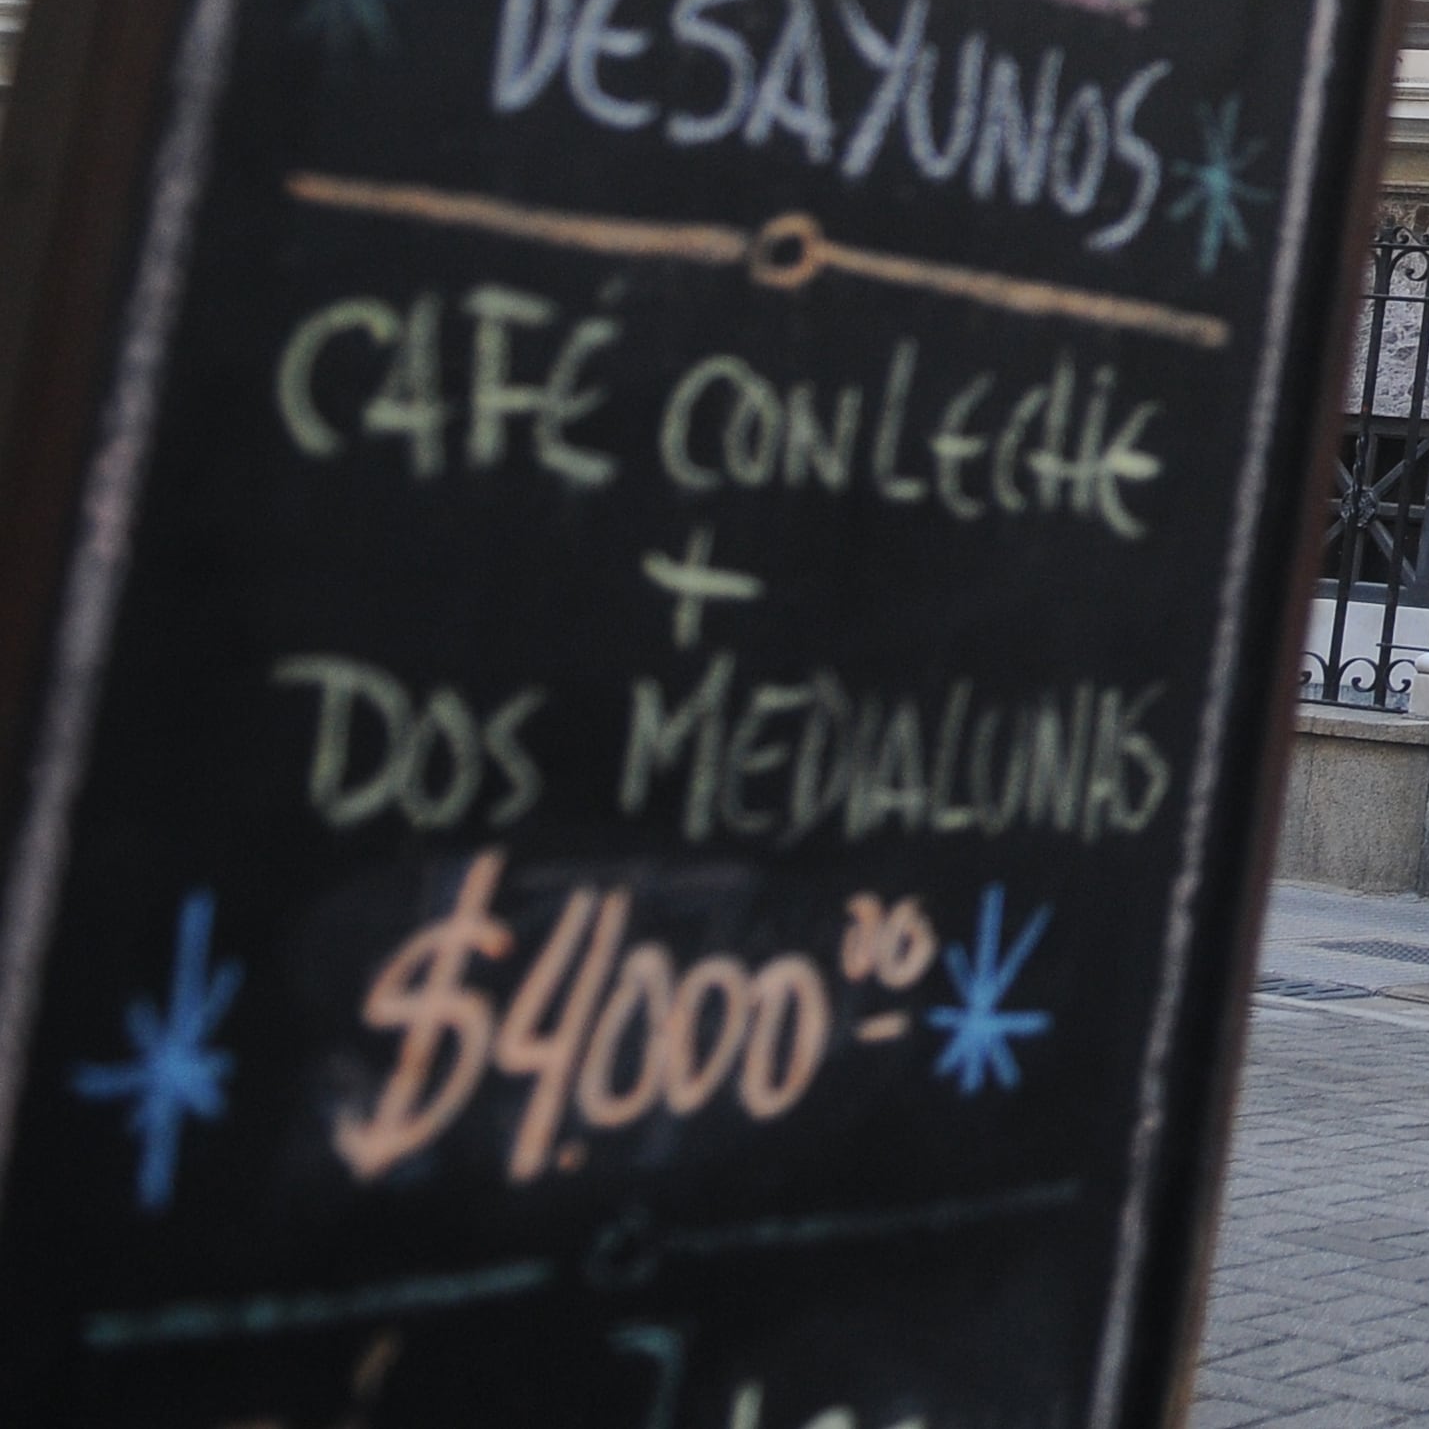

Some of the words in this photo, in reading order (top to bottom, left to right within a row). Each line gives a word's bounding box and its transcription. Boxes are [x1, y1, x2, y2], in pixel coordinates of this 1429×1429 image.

[642, 526, 765, 651] +
[272, 653, 546, 833] DOS
[618, 649, 1172, 847] MEDIALUNAS
